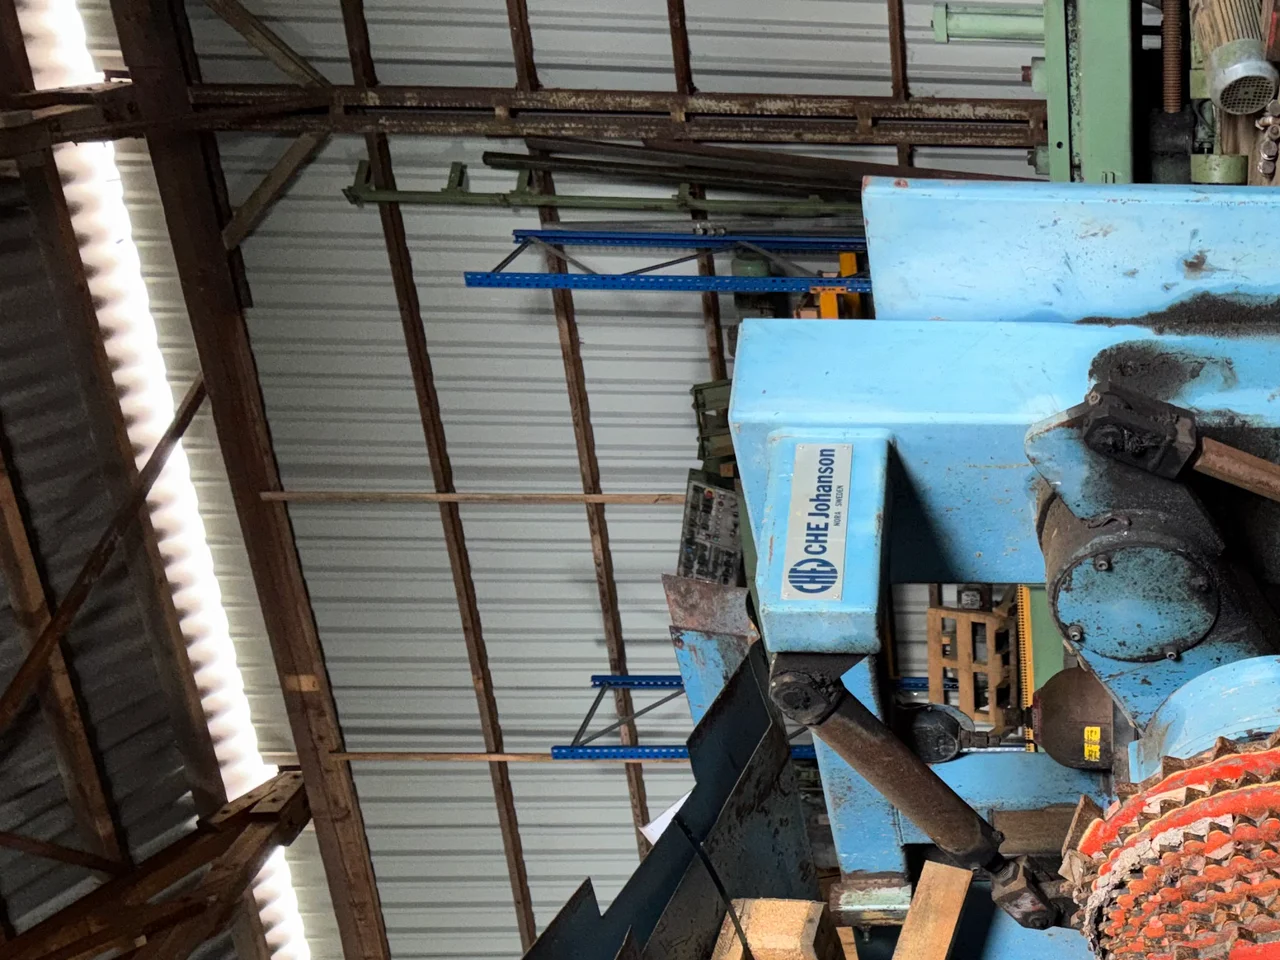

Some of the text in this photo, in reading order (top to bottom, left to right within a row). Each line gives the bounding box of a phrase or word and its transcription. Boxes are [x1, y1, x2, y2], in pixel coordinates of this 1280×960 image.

[804, 449, 835, 555] CHE Johanson
[833, 485, 844, 527] NORA SWEDEN
[788, 558, 838, 594] CHEJ
